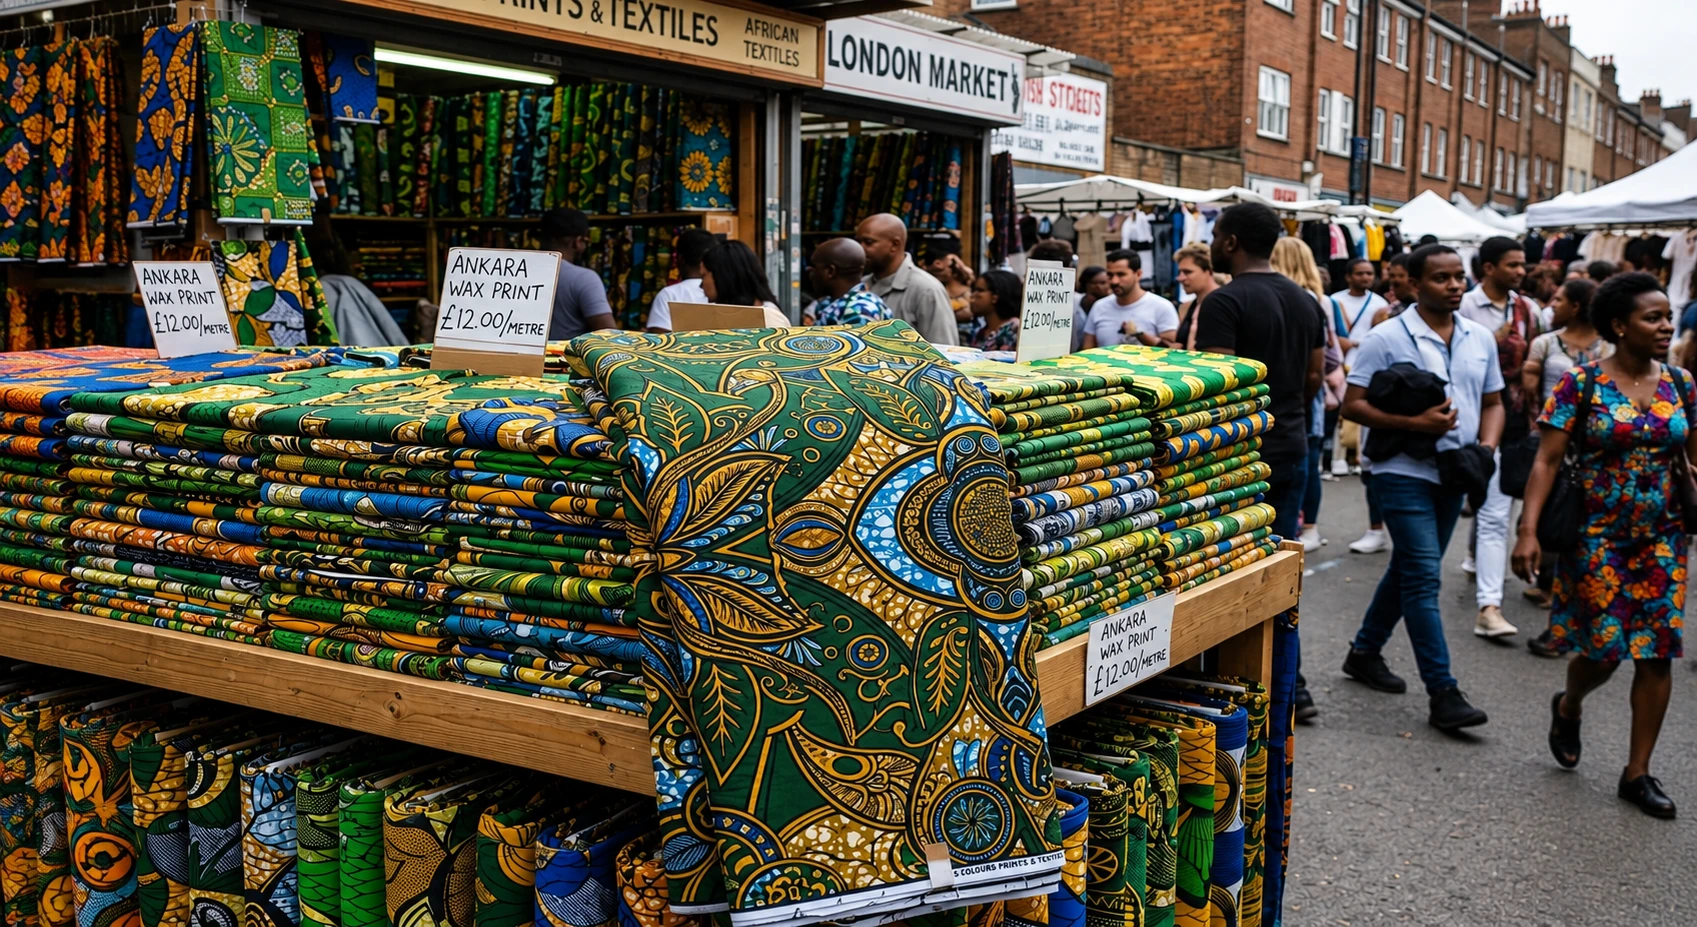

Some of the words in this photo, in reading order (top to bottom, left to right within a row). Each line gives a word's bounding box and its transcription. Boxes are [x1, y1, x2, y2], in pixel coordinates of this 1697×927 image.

[591, 0, 603, 24] &
[611, 0, 719, 47] TEXTILES
[745, 17, 800, 45] AFRICAN
[743, 40, 800, 68] TEXTILES
[828, 29, 921, 85] LONDON
[929, 53, 1009, 102] MARKET
[143, 267, 202, 285] ANKARA
[451, 254, 528, 278] ANKARA
[1027, 270, 1064, 286] ANKARA
[146, 290, 175, 305] WAX
[177, 289, 216, 305] PRINT
[449, 280, 485, 298] WAX
[491, 281, 545, 301] PRINT
[1026, 291, 1044, 304] WAX
[1046, 289, 1071, 304] PRINT
[154, 311, 230, 337] £12.00/METRE
[440, 304, 545, 338] £12.00/METRE
[1101, 609, 1147, 641] ANKARA
[1100, 639, 1124, 661] WAX
[1128, 626, 1158, 650] PRINT
[1093, 648, 1167, 697] £12.00/METRE
[960, 863, 997, 876] COLOURS
